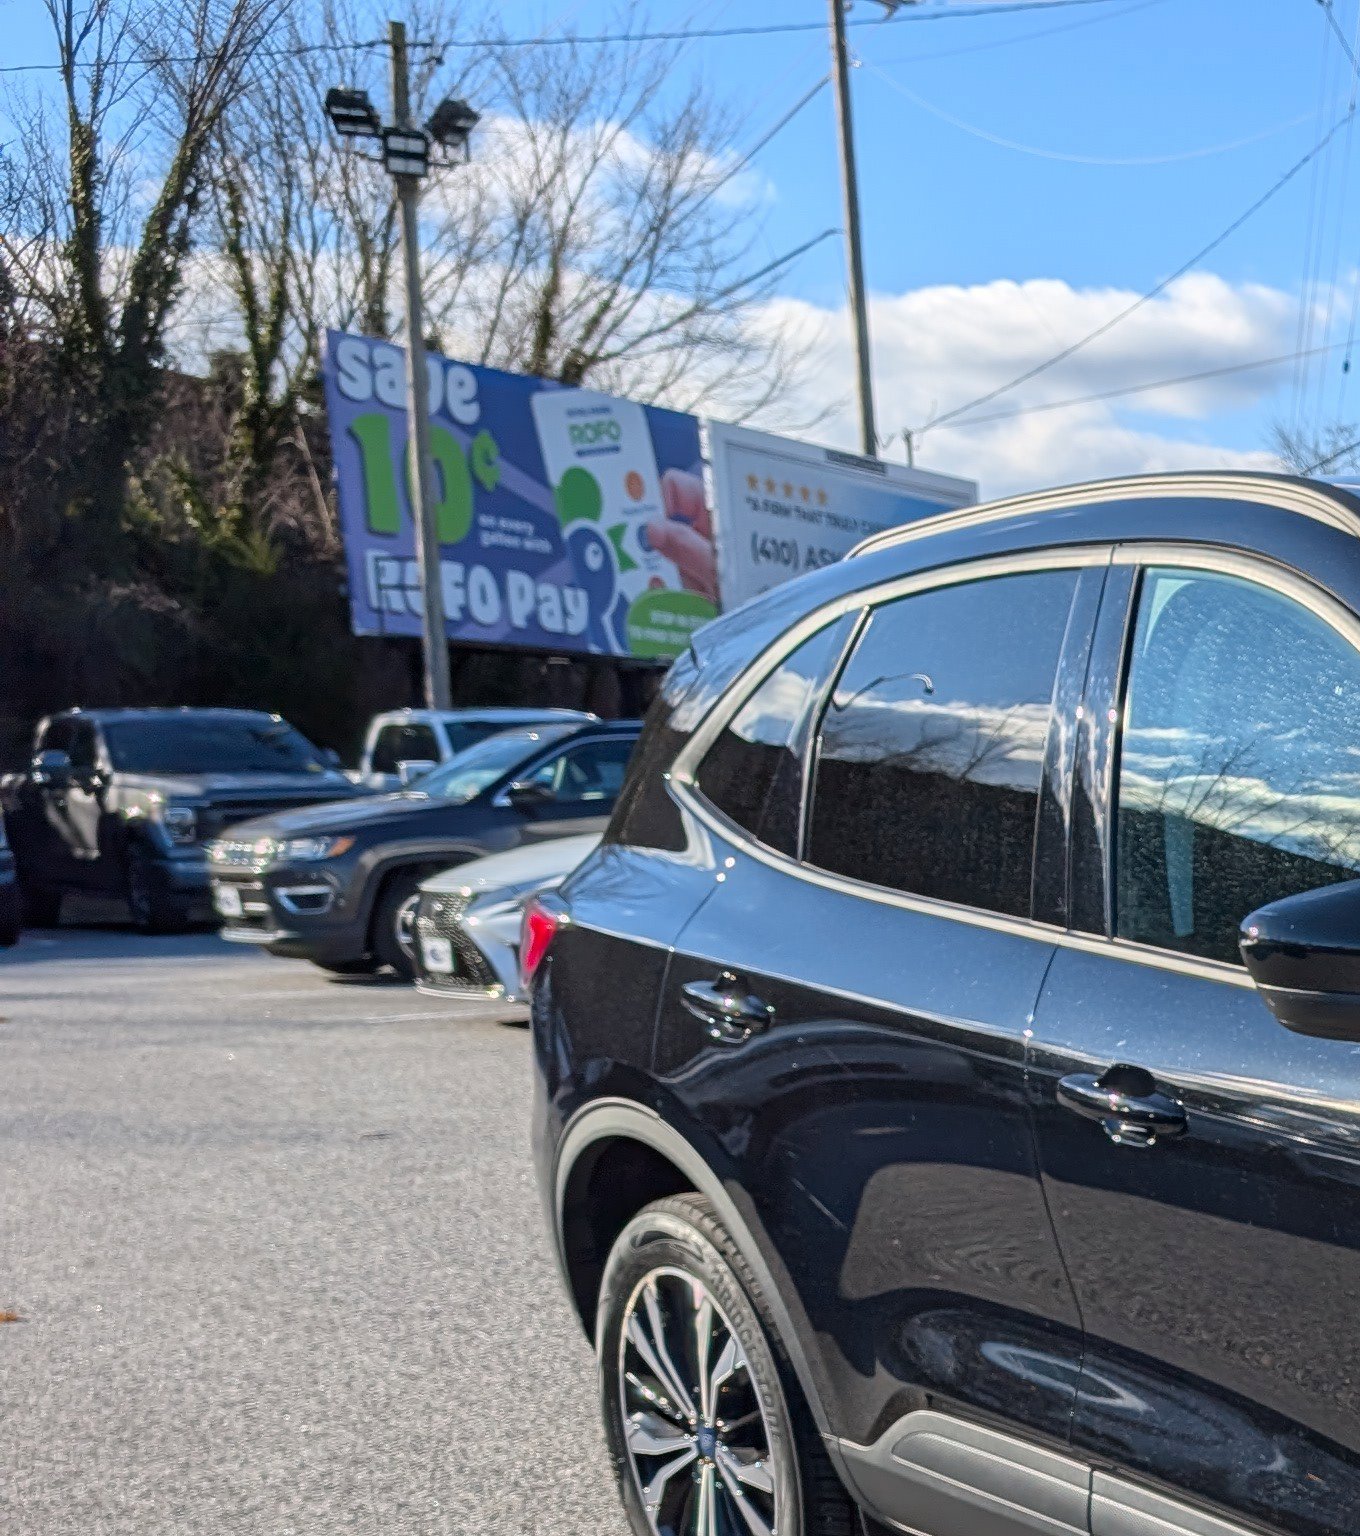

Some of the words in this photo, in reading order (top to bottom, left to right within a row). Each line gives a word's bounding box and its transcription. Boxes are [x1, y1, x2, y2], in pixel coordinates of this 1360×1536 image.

[567, 419, 622, 446] ROFO
[752, 531, 799, 571] (410)
[506, 569, 589, 636] Pay
